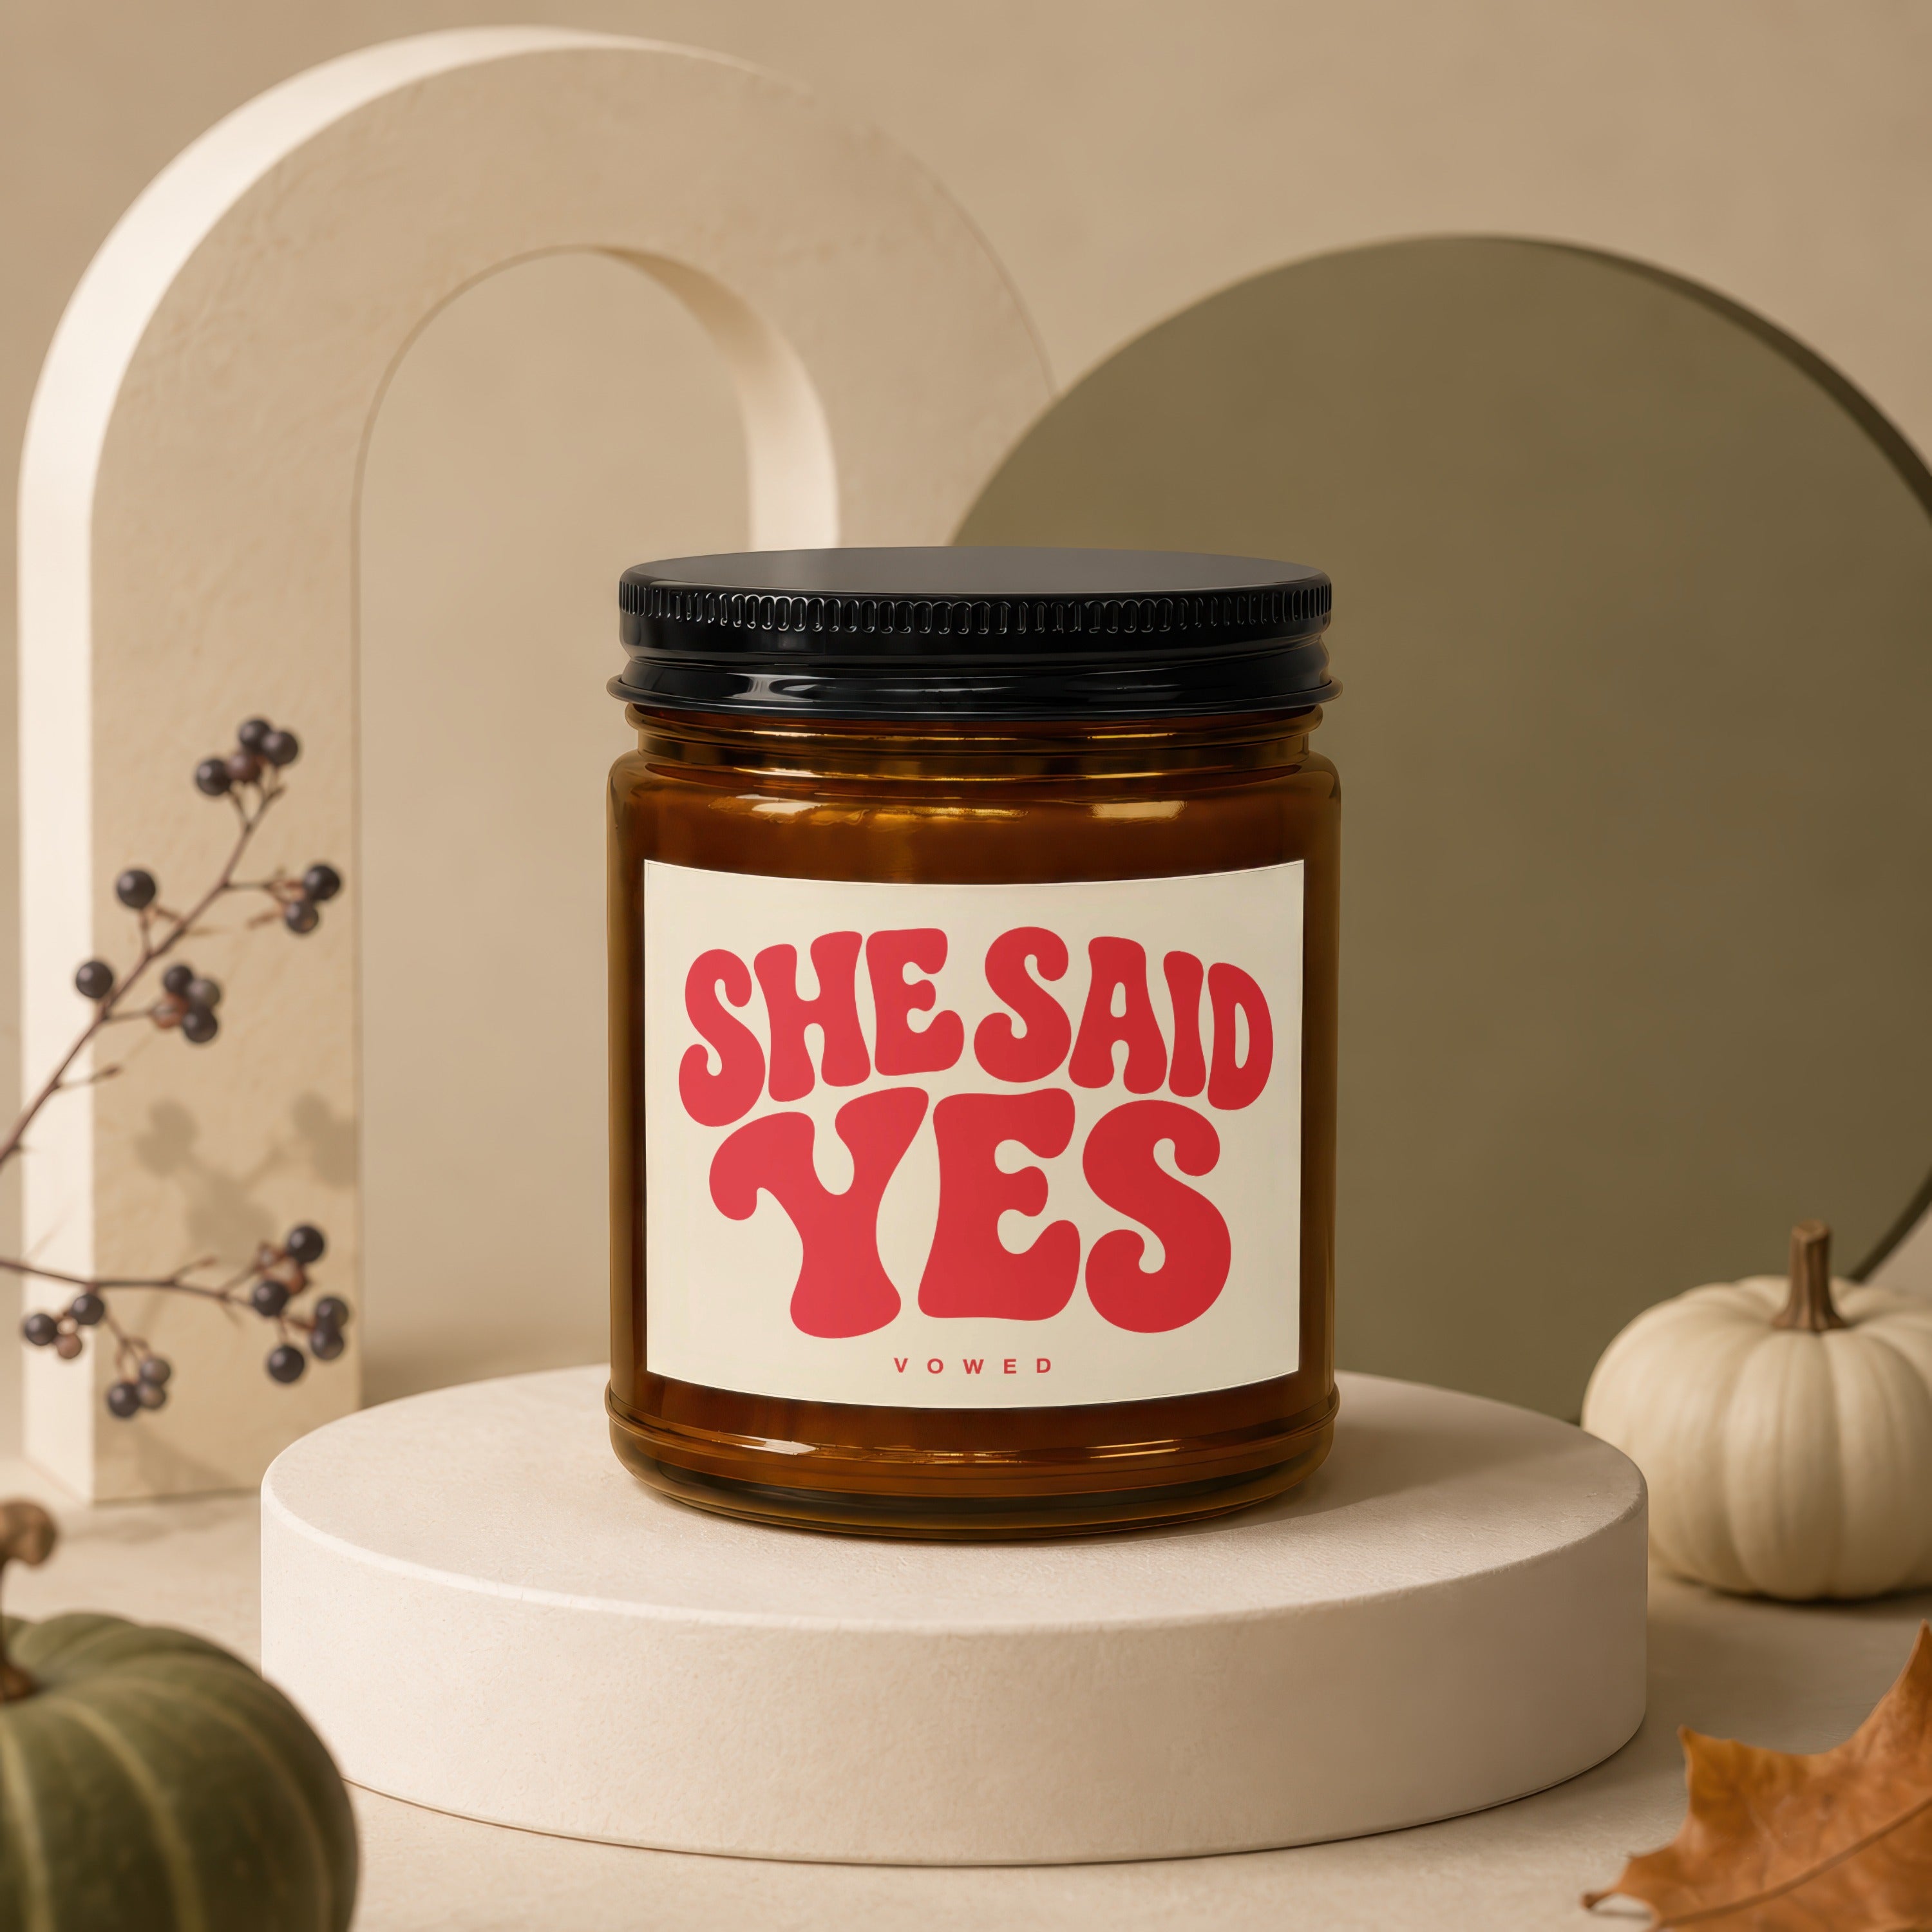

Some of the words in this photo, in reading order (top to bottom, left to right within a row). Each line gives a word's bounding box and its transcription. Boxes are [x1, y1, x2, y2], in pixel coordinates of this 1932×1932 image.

[678, 927, 965, 1128] SHE
[973, 925, 1274, 1111] SAID
[708, 1086, 1232, 1340] YES
[893, 1357, 1052, 1375] VOWED
